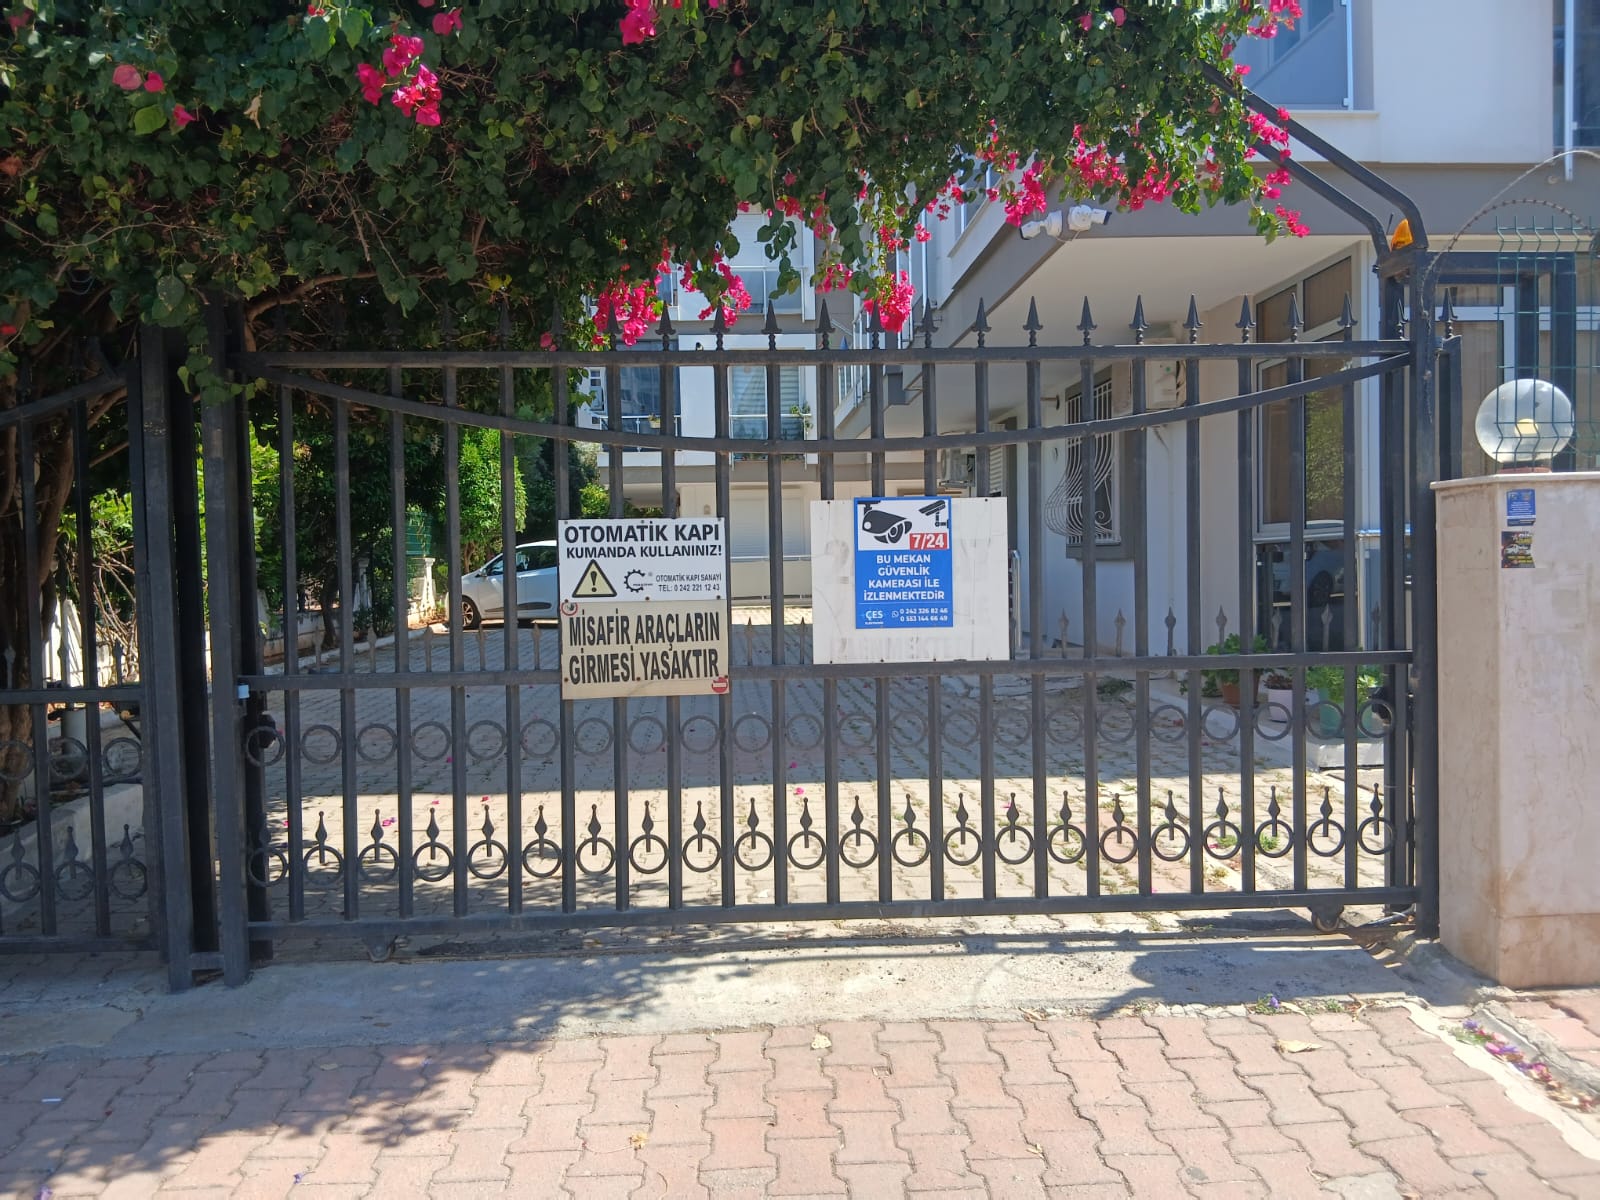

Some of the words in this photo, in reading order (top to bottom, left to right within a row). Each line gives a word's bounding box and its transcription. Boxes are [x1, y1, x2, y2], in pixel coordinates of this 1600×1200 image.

[564, 520, 668, 543] OTOMATİK
[675, 524, 719, 541] KAPI
[912, 534, 945, 549] 7/24
[566, 546, 636, 559] KUMANDA
[640, 545, 722, 557] KULLANINIZ!
[876, 555, 891, 564] BU
[893, 554, 931, 563] MEKAN
[878, 564, 930, 576] GÜVENLİK
[655, 572, 685, 582] OTOMATİK
[686, 574, 700, 582] KAPI
[700, 572, 722, 581] SANAYİ
[868, 579, 921, 589] KAMERASI
[924, 576, 940, 587] İLE
[658, 584, 672, 592] TEL:
[673, 584, 678, 592] 0
[679, 584, 690, 592] 242
[712, 583, 720, 591] 43
[865, 610, 884, 621] ÇES
[569, 608, 630, 646] MİSAFİR
[635, 611, 720, 651] ARAÇLARIN
[569, 646, 636, 685] GİRMESİ
[640, 649, 719, 681] YASAKTIR
